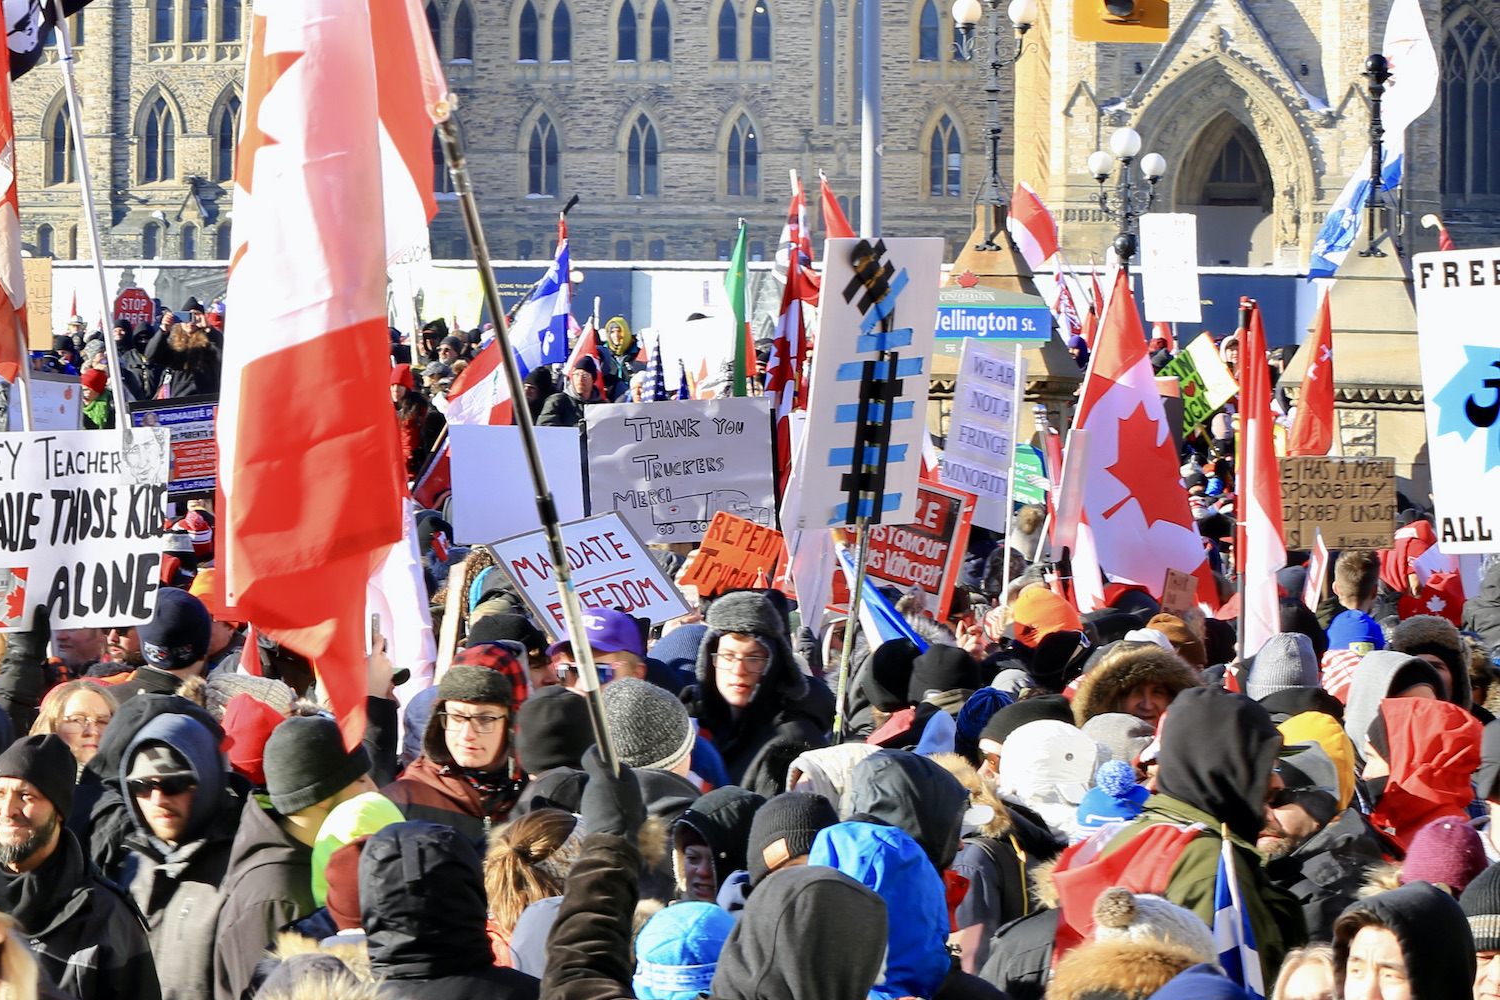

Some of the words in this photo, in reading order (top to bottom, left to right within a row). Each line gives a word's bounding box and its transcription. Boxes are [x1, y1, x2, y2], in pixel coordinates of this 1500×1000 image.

[121, 298, 148, 311] STOP
[1021, 317, 1037, 332] St.
[973, 356, 995, 380] WE
[970, 390, 997, 415] NOT
[624, 417, 701, 442] THANK
[712, 417, 745, 435] YOU
[957, 424, 1009, 456] FRINGE
[34, 436, 122, 481] TEACHER
[632, 454, 725, 482] TRUCKERS
[1303, 460, 1330, 480] HAS
[1336, 460, 1347, 480] A
[1281, 481, 1388, 500] SPONSABILITY
[50, 487, 118, 547] THOSE
[125, 483, 168, 539] KIDS
[1282, 503, 1340, 522] DISOBEY
[708, 513, 784, 559] REPENT
[1441, 516, 1493, 543] ALL
[511, 531, 632, 588] MADATE
[48, 552, 160, 620] ALONE
[546, 577, 668, 632] FEEDOM
